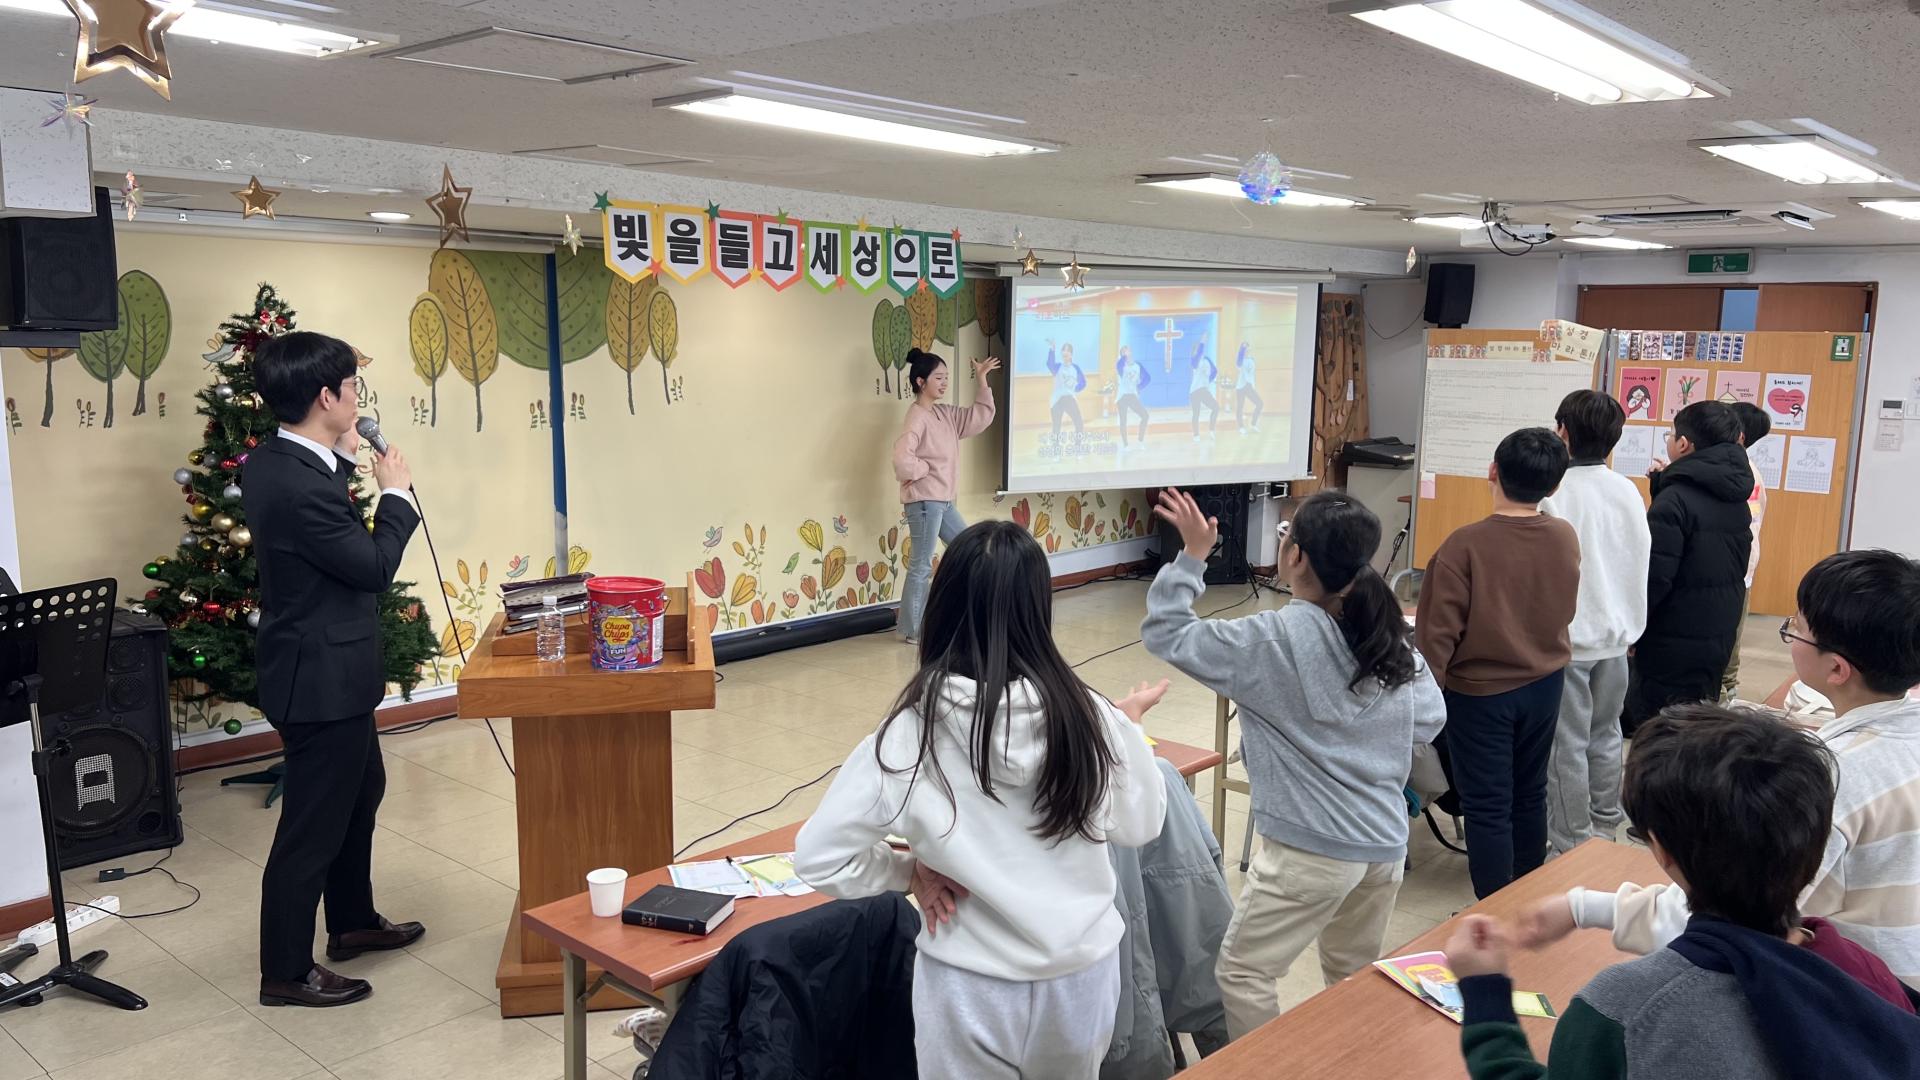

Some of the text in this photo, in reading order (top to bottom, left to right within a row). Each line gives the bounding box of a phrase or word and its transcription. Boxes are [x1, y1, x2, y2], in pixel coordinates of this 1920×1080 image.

[1566, 327, 1588, 340] 성경
[1551, 342, 1595, 360] 마라톤!!
[604, 622, 631, 631] Chupa
[604, 630, 630, 638] Chups
